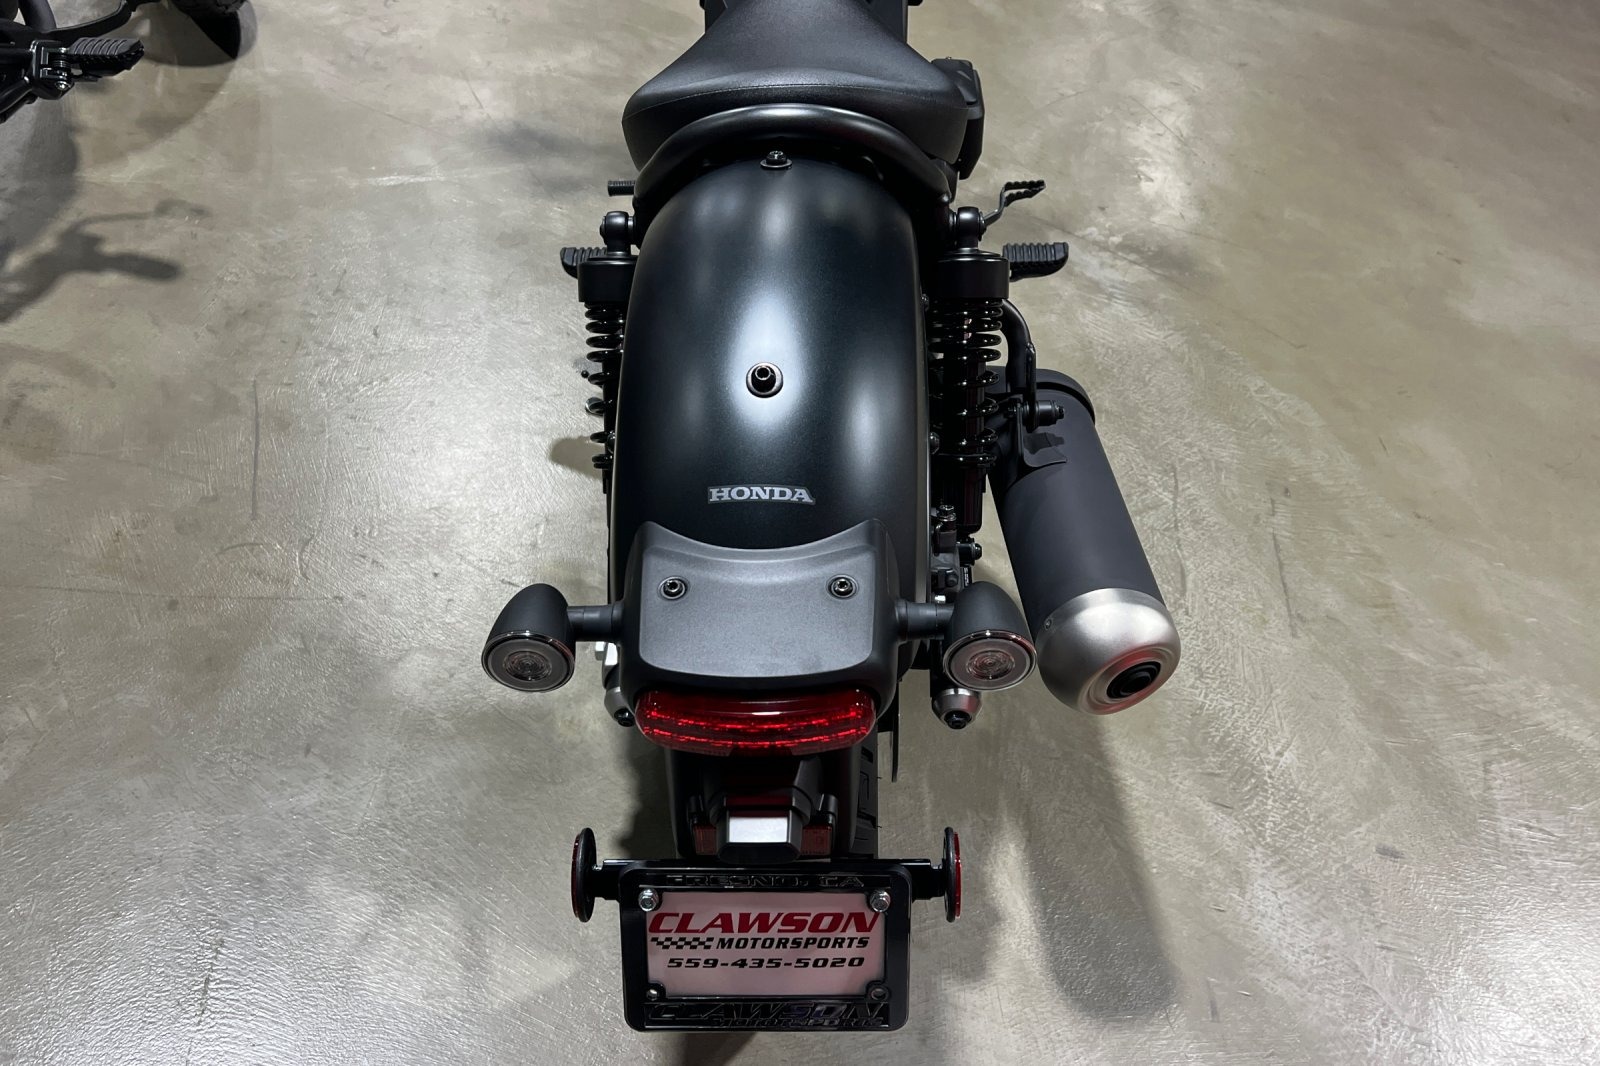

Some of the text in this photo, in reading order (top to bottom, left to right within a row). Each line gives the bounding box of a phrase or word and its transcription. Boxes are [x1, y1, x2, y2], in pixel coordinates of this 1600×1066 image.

[709, 486, 814, 503] HONDA
[648, 912, 879, 934] CLAWSON
[716, 936, 870, 949] MOTORSPORTS
[667, 957, 865, 969] 559-435-5020
